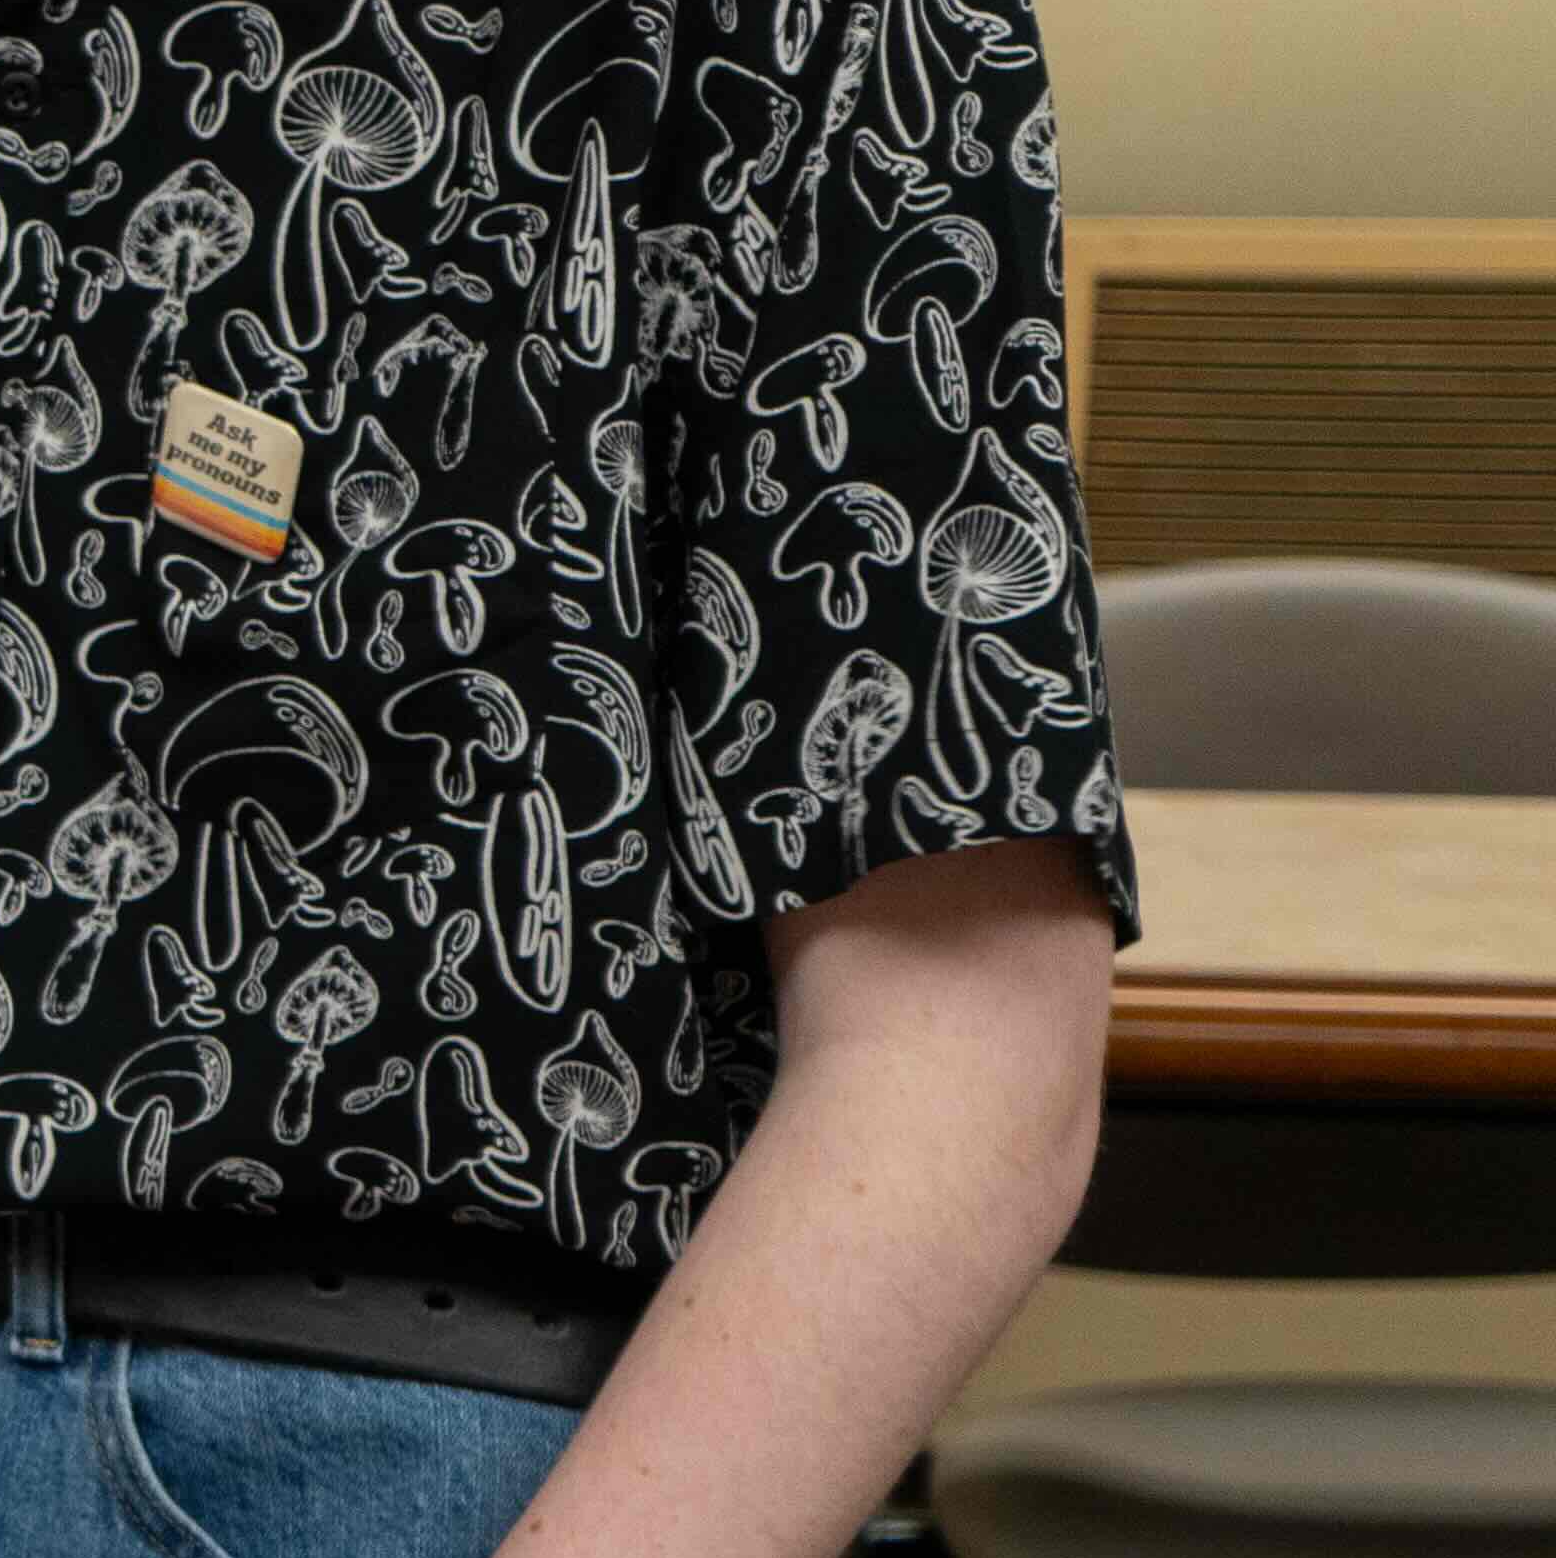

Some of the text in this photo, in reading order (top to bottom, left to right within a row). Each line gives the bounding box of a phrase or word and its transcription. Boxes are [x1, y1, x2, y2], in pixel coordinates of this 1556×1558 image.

[189, 431, 267, 477] me my
[206, 413, 258, 451] Ask
[167, 444, 283, 505] pronouns
